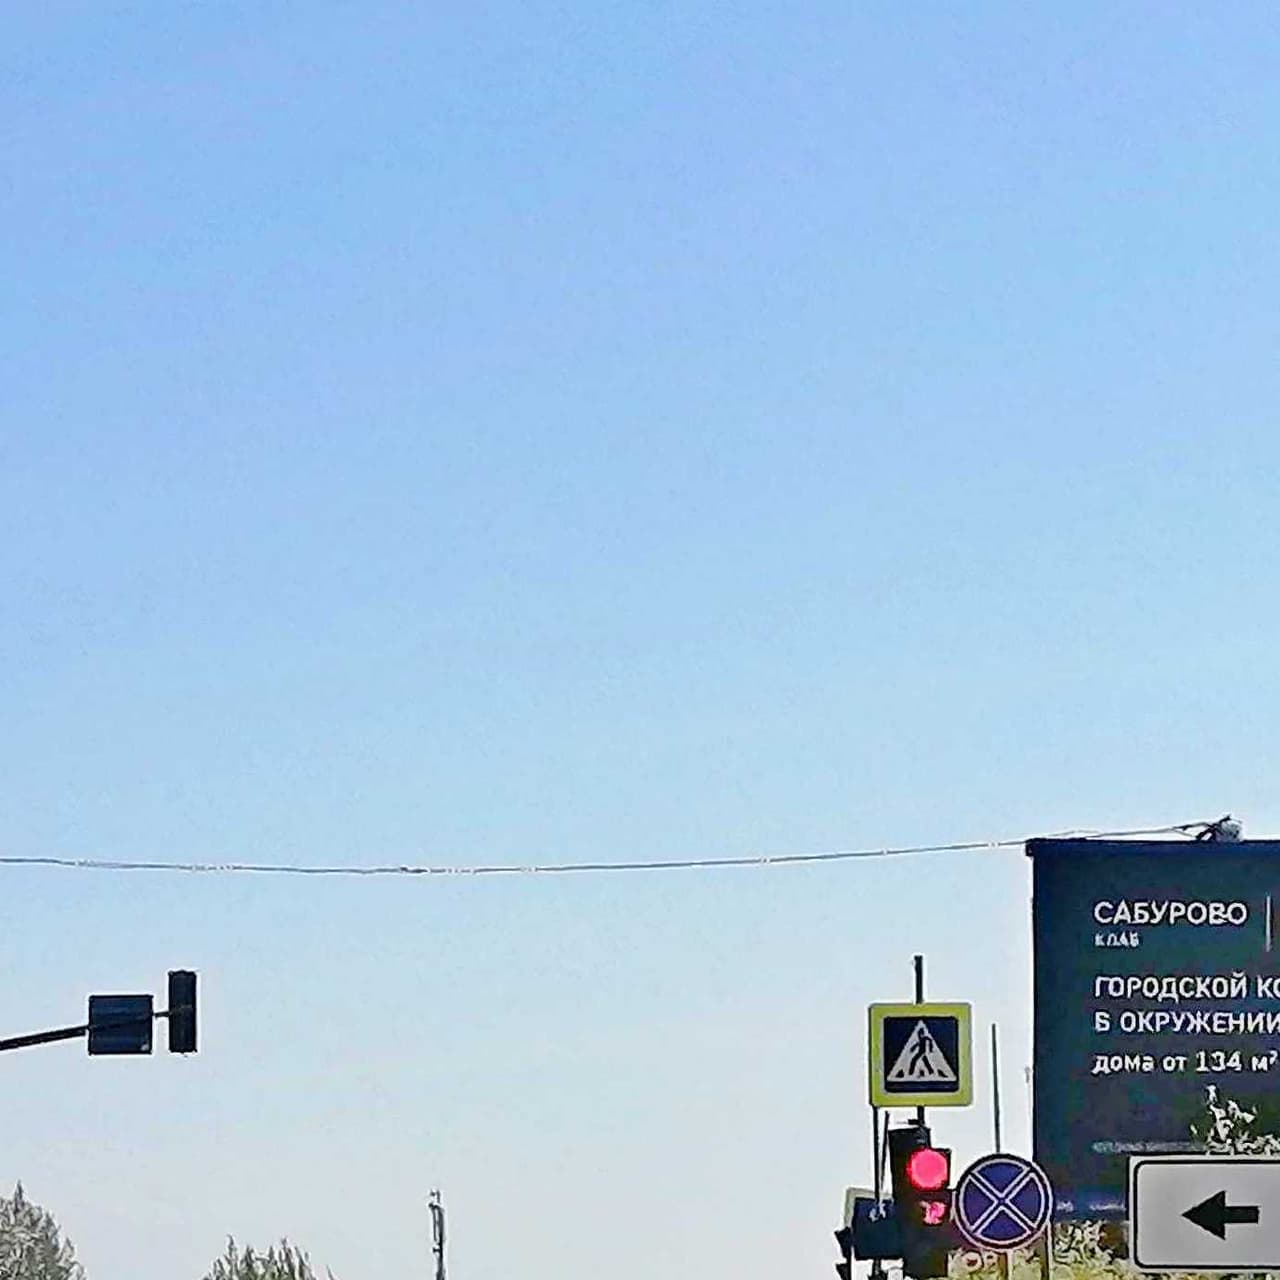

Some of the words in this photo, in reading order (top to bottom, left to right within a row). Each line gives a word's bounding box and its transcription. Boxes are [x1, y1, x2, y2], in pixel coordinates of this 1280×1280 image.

[1093, 900, 1249, 925] САБУРОВО
[1094, 971, 1248, 1003] ГОРОДСКОЙ
[1162, 1054, 1188, 1072] от
[1195, 1050, 1242, 1072] 134
